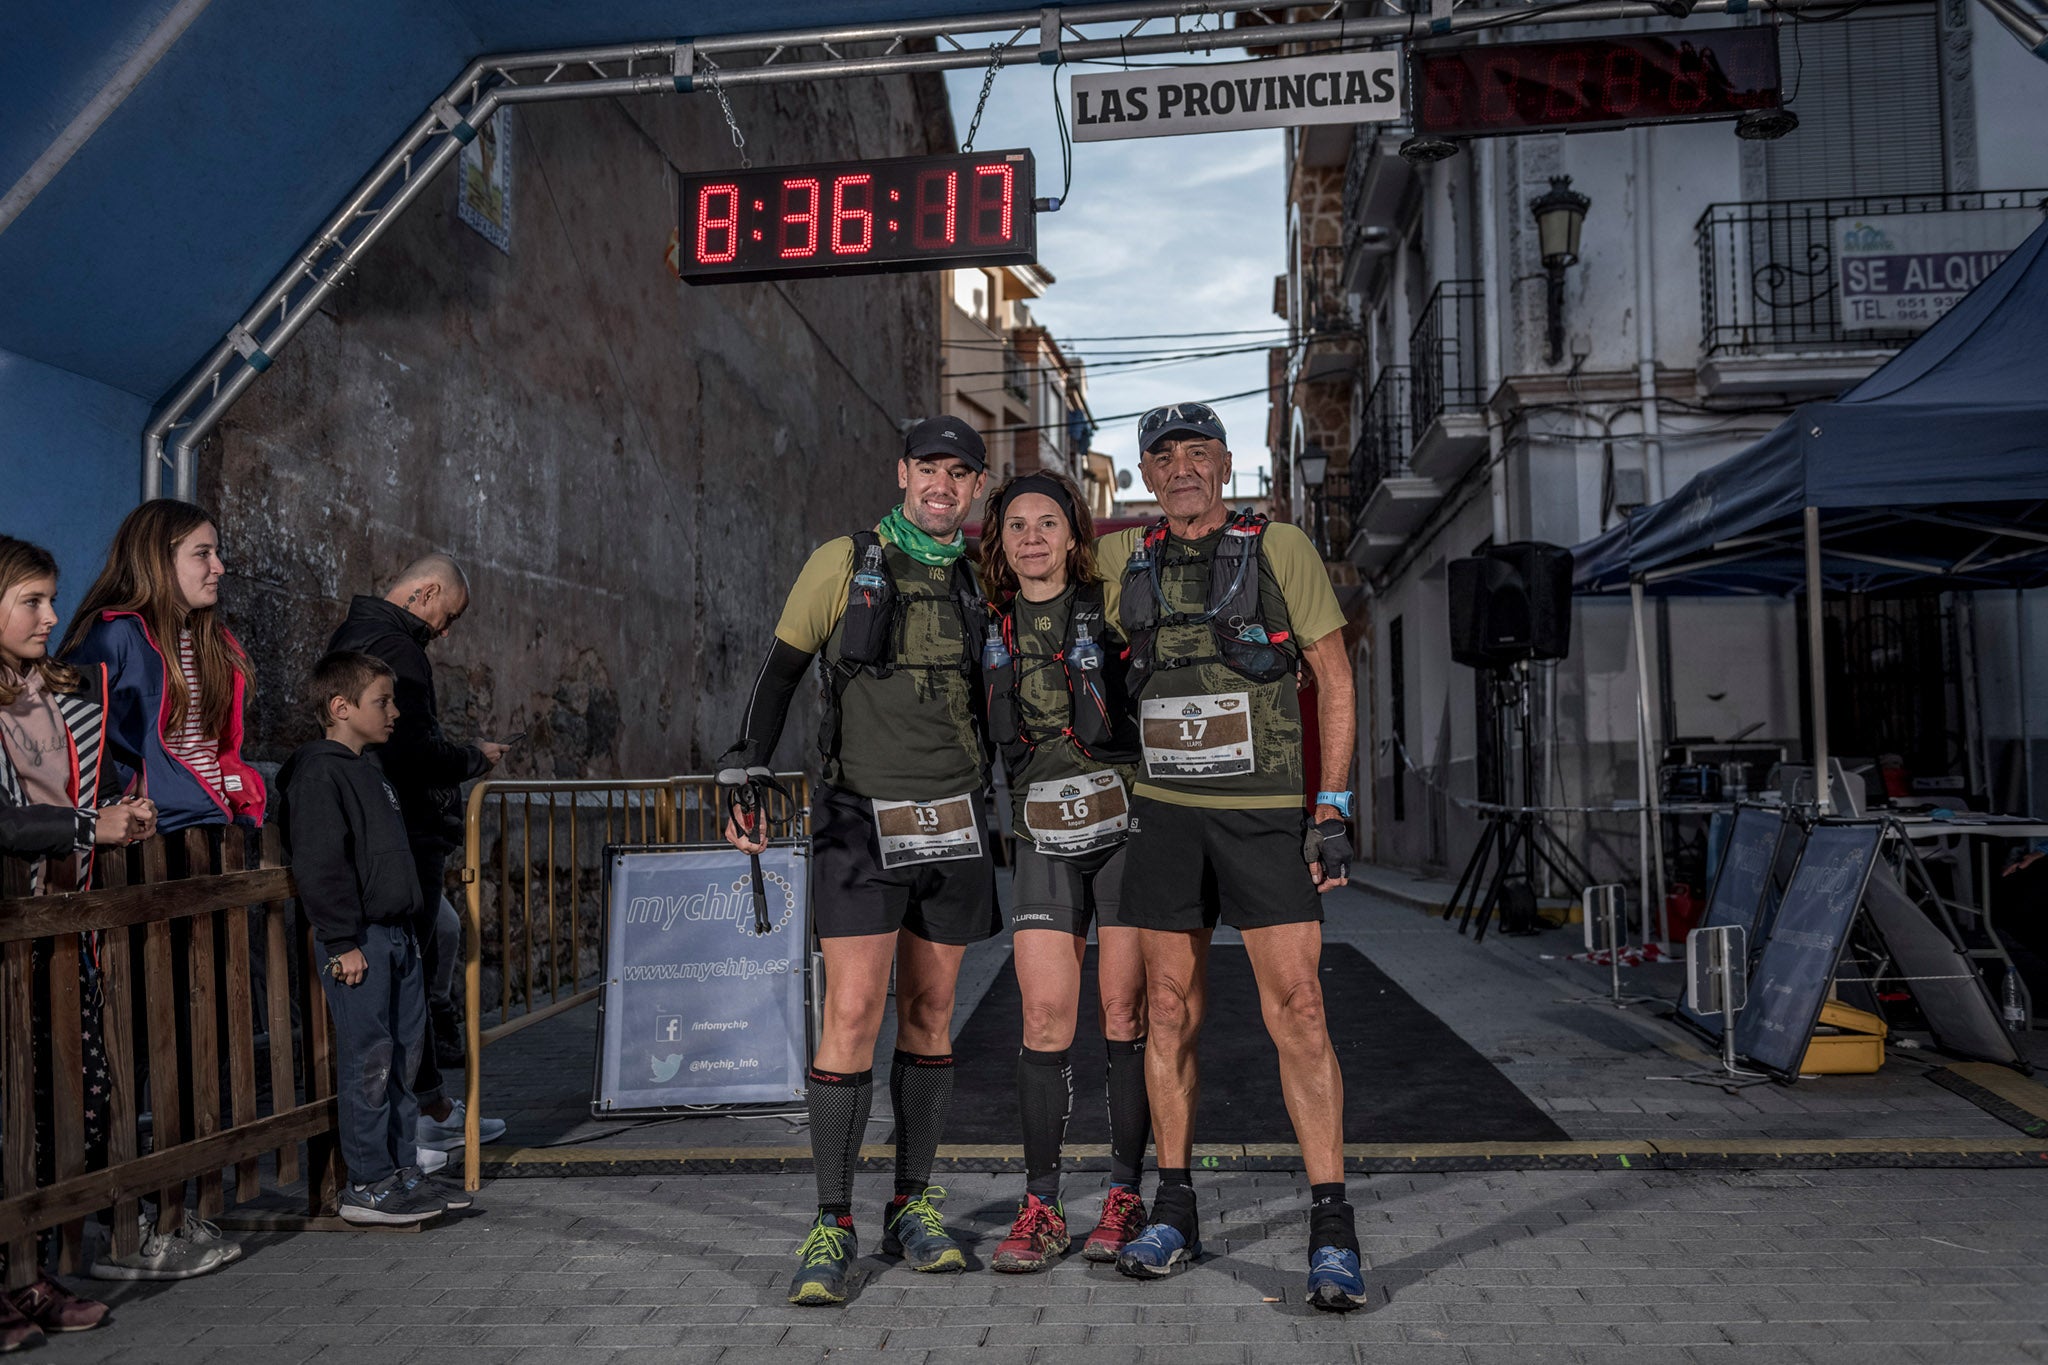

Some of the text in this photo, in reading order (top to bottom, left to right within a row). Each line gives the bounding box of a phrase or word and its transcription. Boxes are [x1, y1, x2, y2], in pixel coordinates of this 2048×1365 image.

[1077, 86, 1148, 125] LAS
[1157, 68, 1395, 119] PROVINCIAS
[1848, 254, 2006, 292] SE ALQU
[1179, 719, 1208, 741] 17
[1186, 740, 1203, 748] LLAPIS
[915, 807, 939, 826] 13
[1059, 798, 1089, 821] 16
[626, 883, 761, 931] mychip
[1016, 913, 1054, 922] LURBEL
[624, 956, 790, 982] www.mychip.es
[691, 1019, 749, 1032] /infomychip
[688, 1058, 759, 1073] @Mychip_Info
